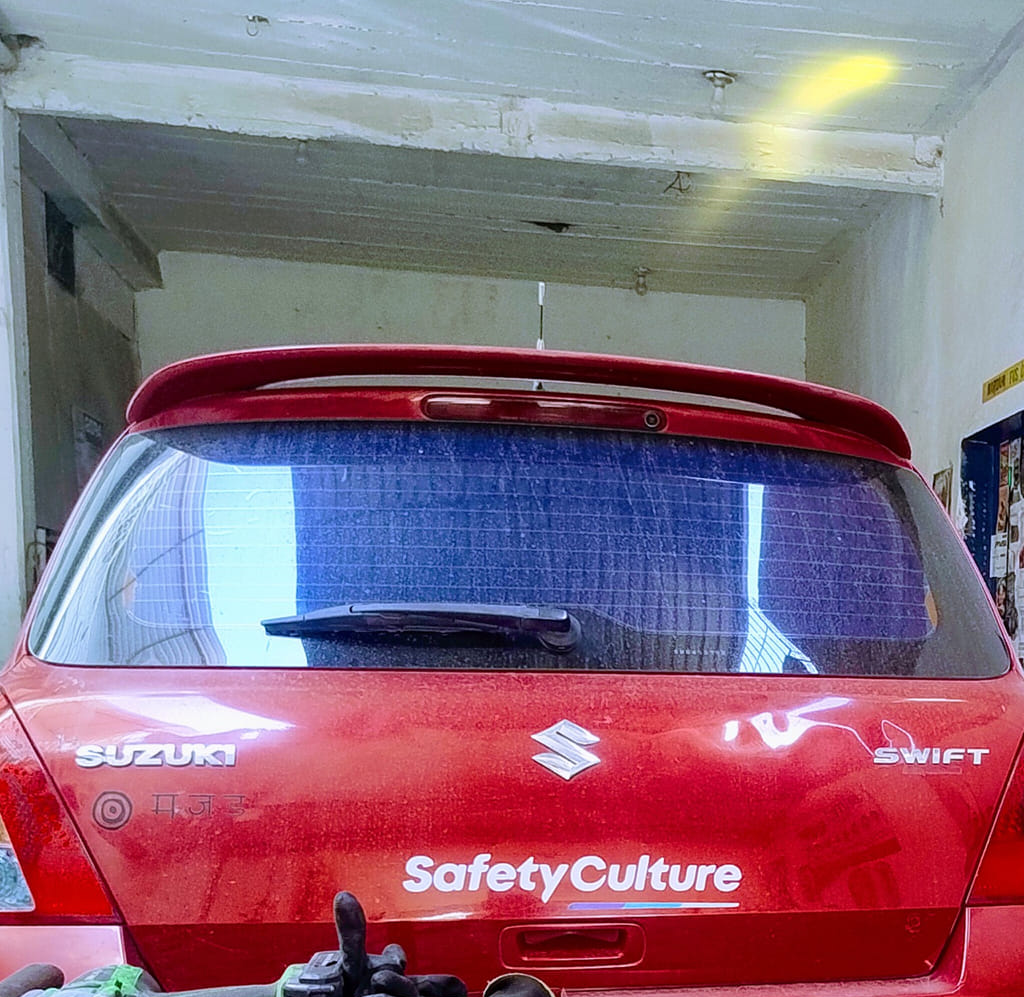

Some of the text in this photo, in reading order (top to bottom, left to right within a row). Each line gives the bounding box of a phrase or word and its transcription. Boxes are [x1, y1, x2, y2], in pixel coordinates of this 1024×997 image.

[75, 743, 237, 768] SUZUKI
[873, 747, 990, 766] SWIFT
[402, 853, 743, 904] SafetyCulture
